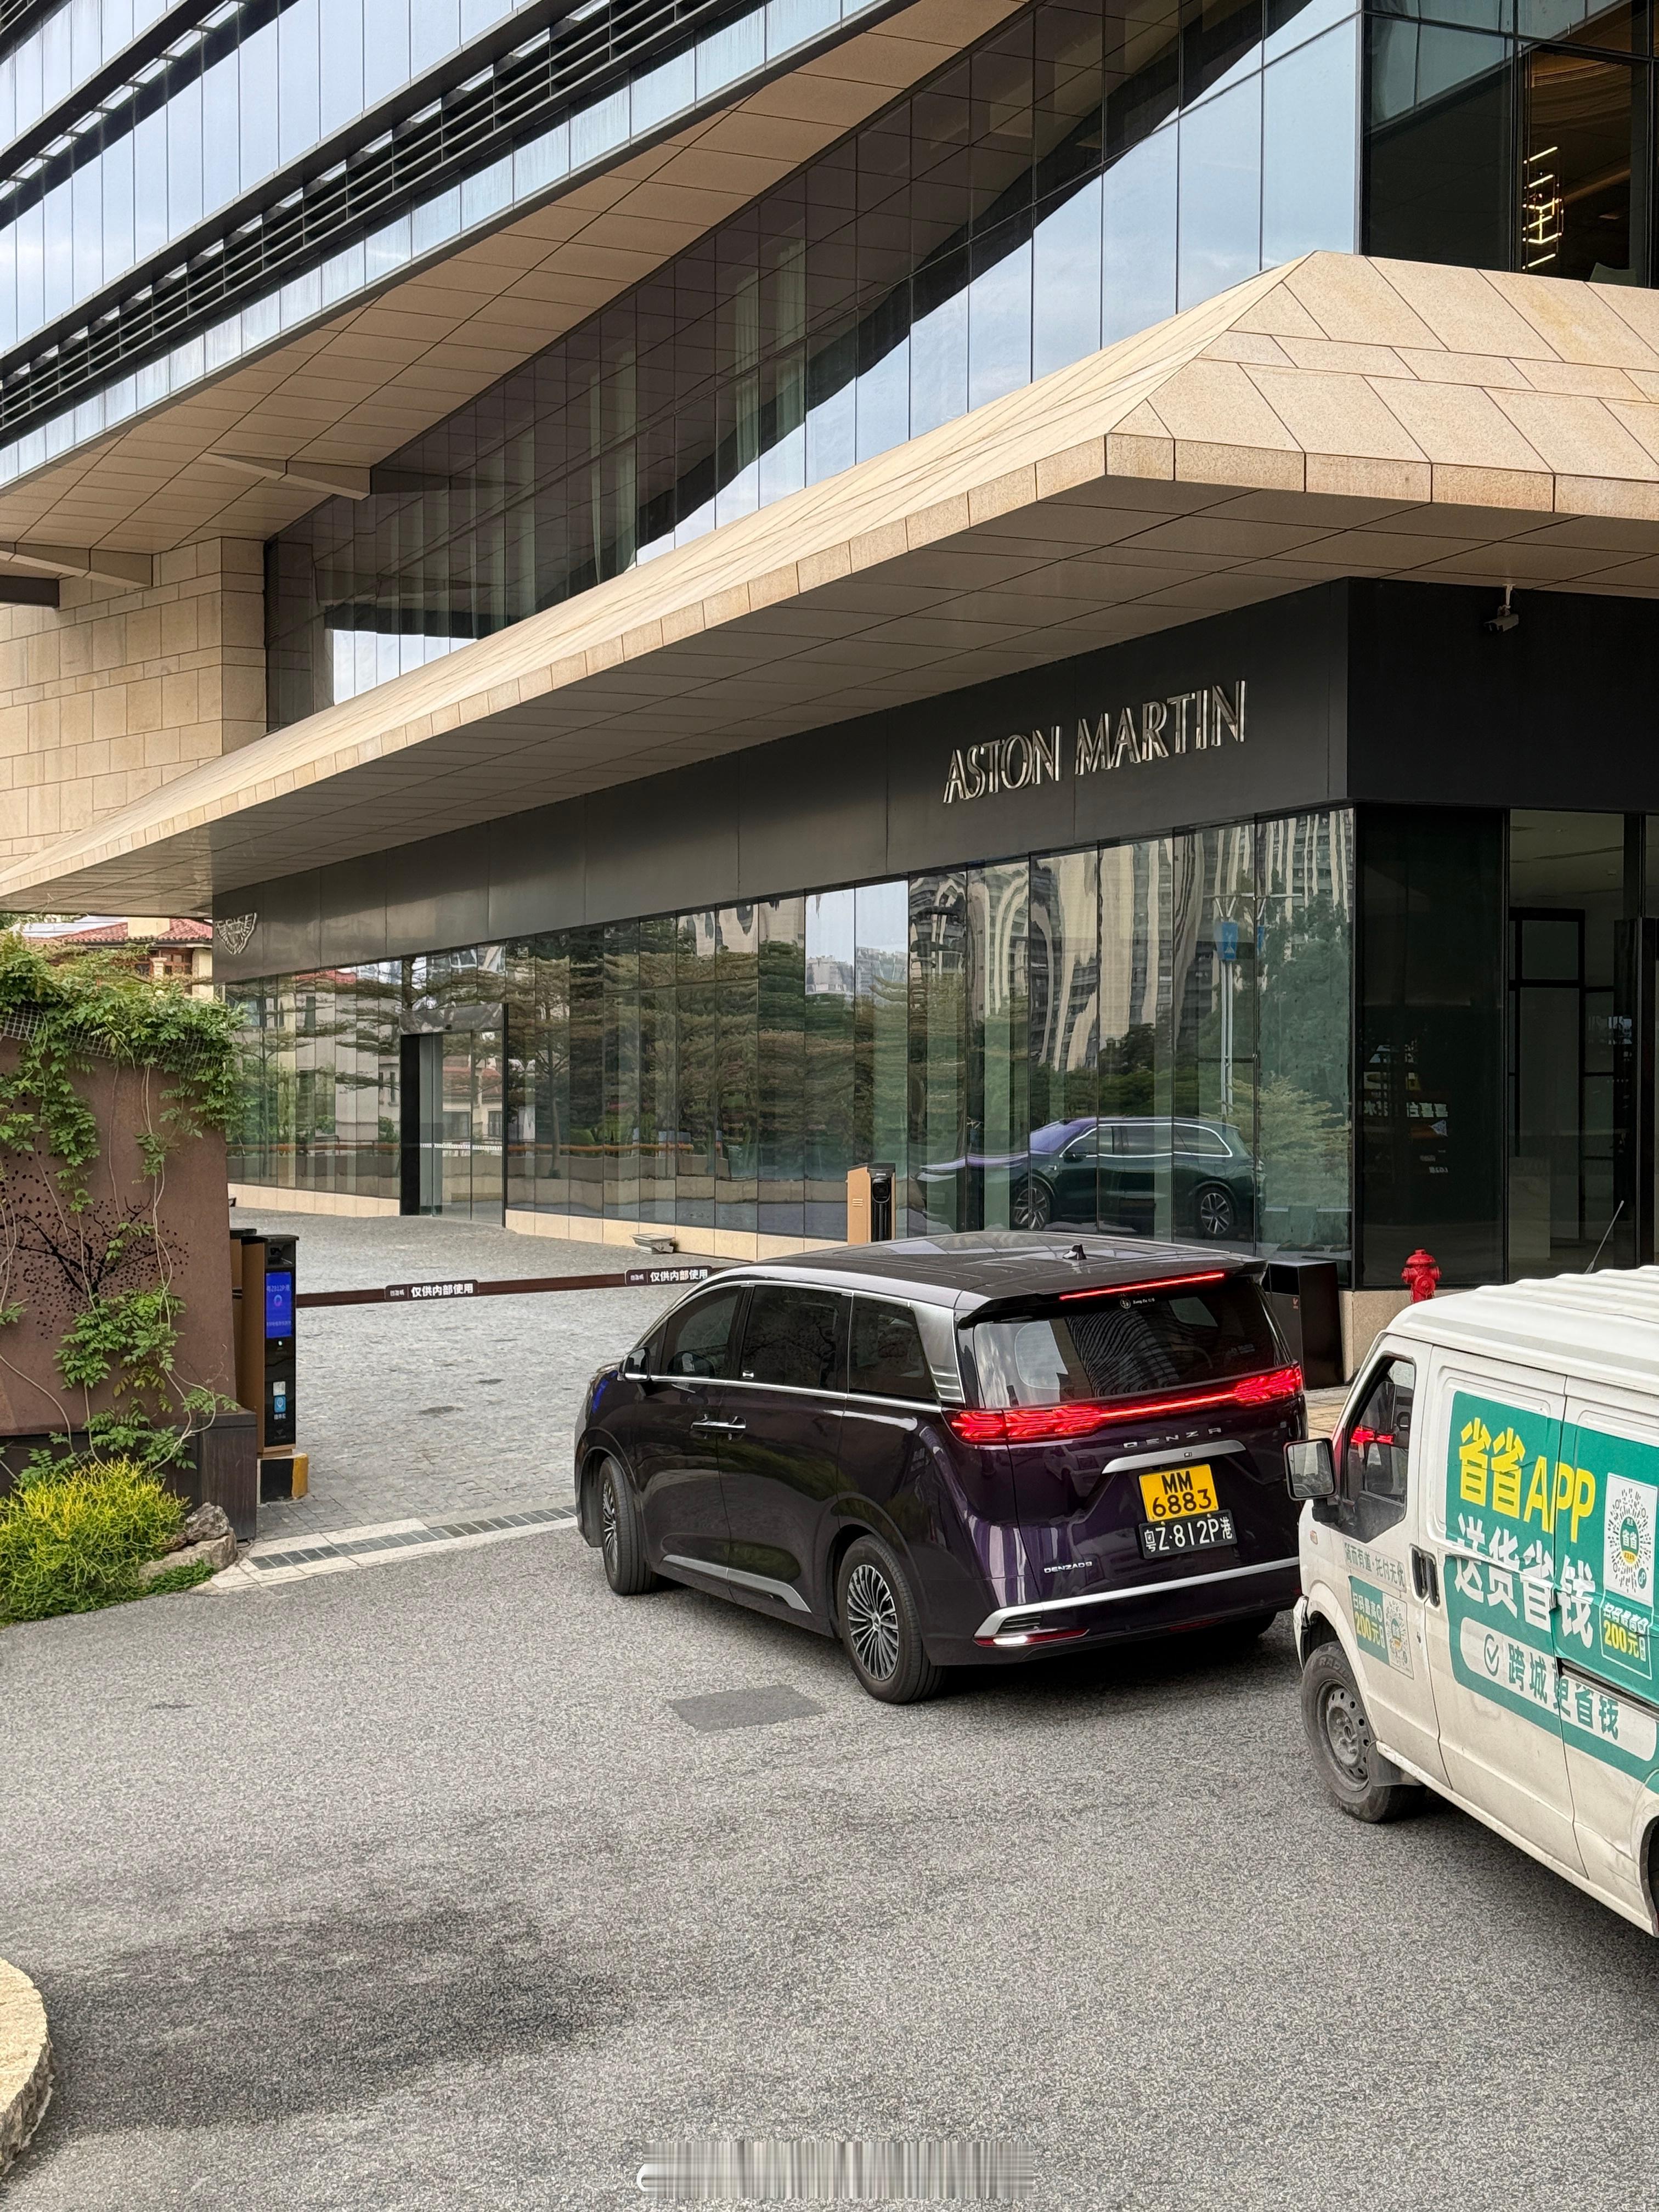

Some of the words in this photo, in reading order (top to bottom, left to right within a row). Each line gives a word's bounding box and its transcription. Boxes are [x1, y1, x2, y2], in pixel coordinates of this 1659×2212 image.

[943, 725, 1061, 803] ASTON
[1074, 680, 1246, 776] MARTIN
[411, 1283, 473, 1297] 仅供内部使用
[650, 1269, 708, 1282] 仅供内部使用
[1153, 1488, 1211, 1517] 6883
[1161, 1470, 1193, 1495] MM
[1459, 1417, 1596, 1543] 省省APP
[1454, 1512, 1596, 1648] 送货省钱
[1508, 1643, 1618, 1740] 跨城更省钱
